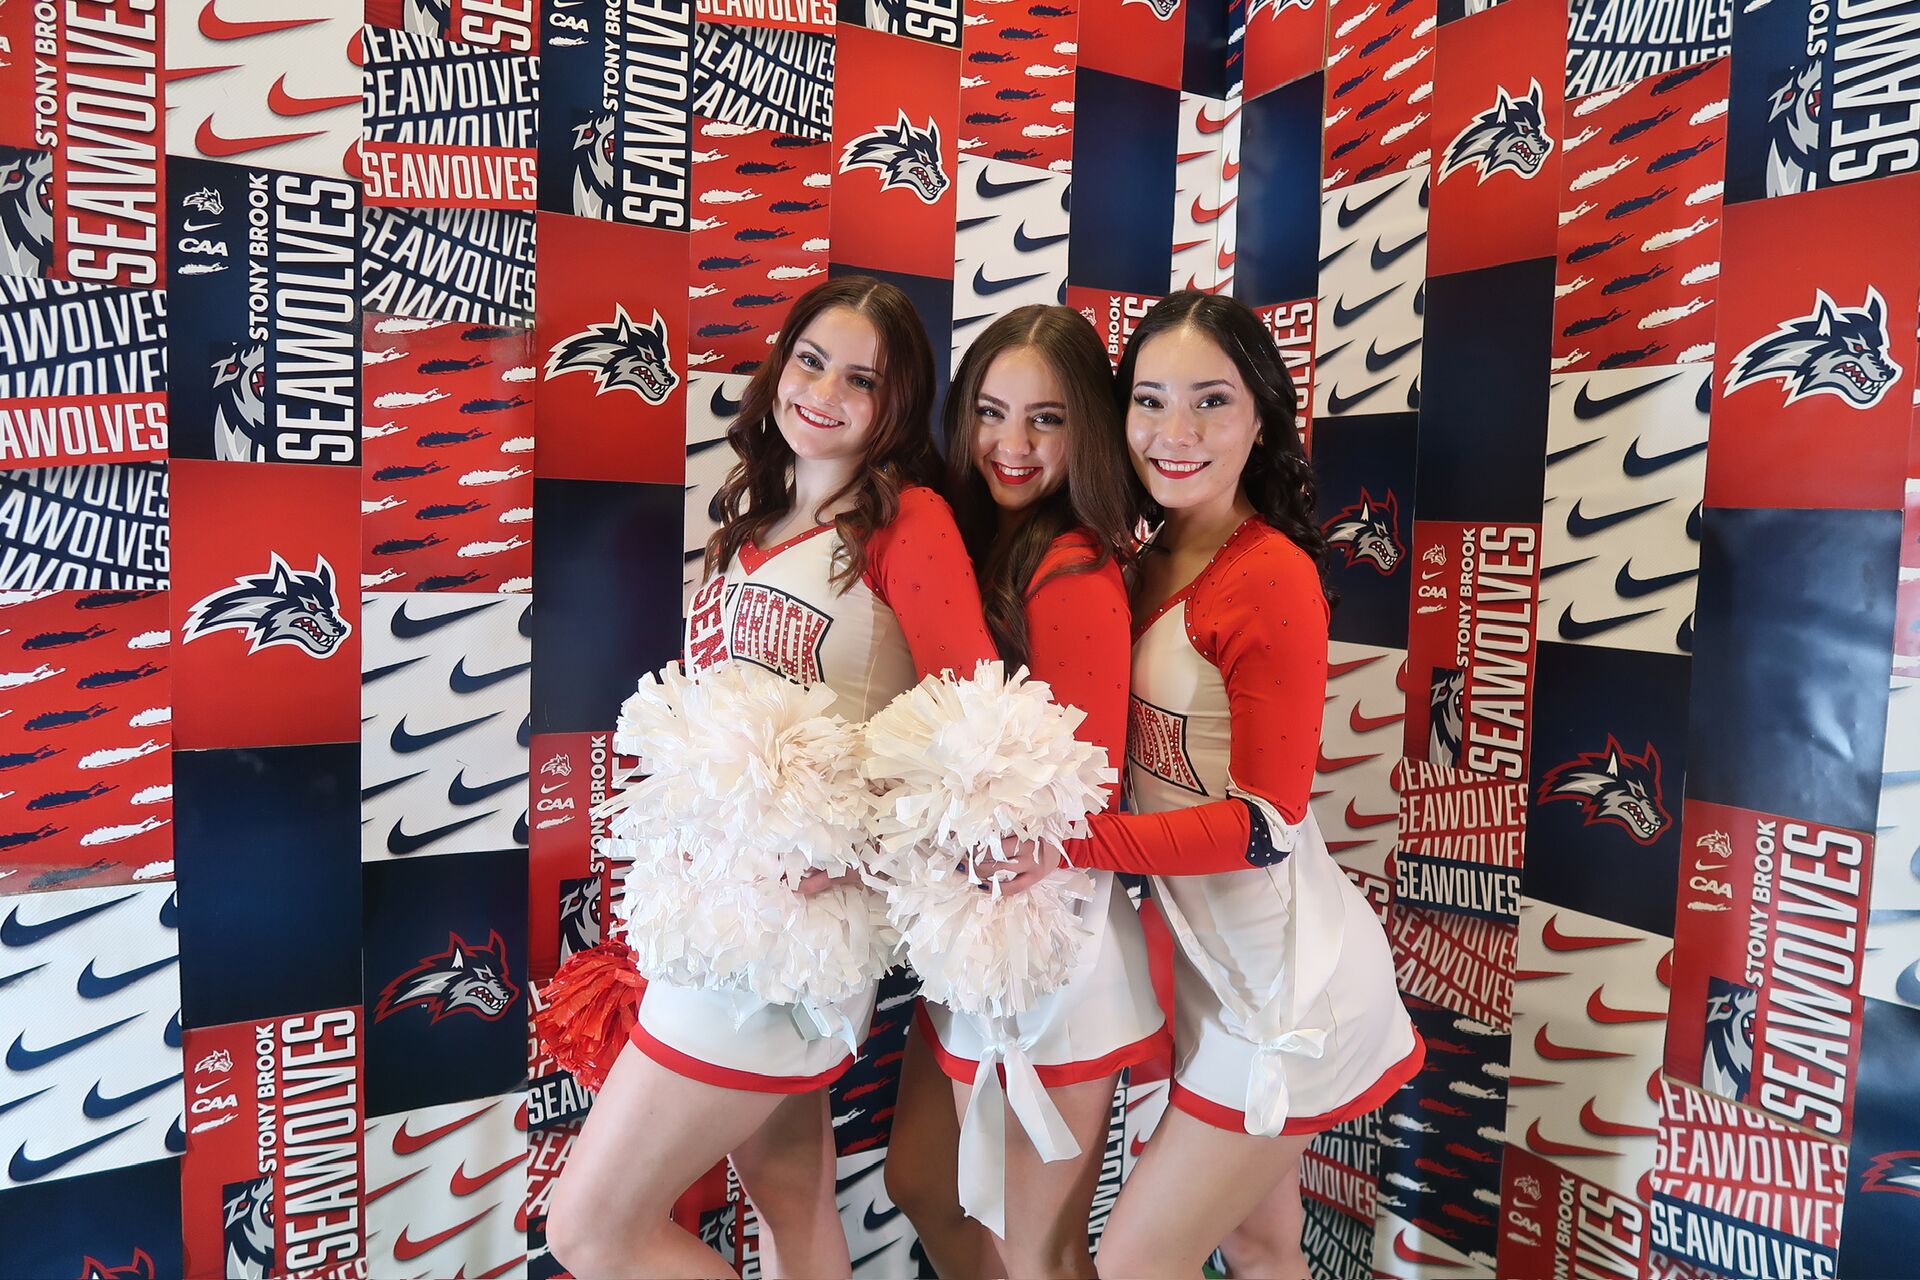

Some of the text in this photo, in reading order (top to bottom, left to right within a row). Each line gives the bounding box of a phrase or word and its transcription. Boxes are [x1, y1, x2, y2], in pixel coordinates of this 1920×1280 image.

[549, 12, 589, 33] CAA
[34, 0, 59, 147] STONY BRO
[602, 36, 621, 112] STONY
[362, 151, 537, 200] SEAWOLVES
[178, 238, 230, 256] CAA
[249, 173, 270, 341] STONY BROOK
[276, 175, 356, 463] SEAWOLVES
[1418, 586, 1447, 598] CAA
[1455, 527, 1476, 668] STONY BROOK
[734, 587, 826, 684] BROOK
[1468, 527, 1535, 780] SEAWOLVES
[536, 798, 575, 811] CAA
[590, 734, 607, 805] BROOK
[1396, 860, 1521, 917] SEAWOLVES
[1690, 877, 1733, 899] CAA
[1745, 819, 1776, 987] STONY BROOK
[1760, 822, 1863, 1135] SEAWOLVES
[191, 1094, 238, 1114] CAA
[256, 1022, 277, 1174] STONY BROOK
[281, 1010, 359, 1270] SEAWOLVES
[1509, 1211, 1542, 1237] CAA
[1556, 1175, 1576, 1248] BROOK
